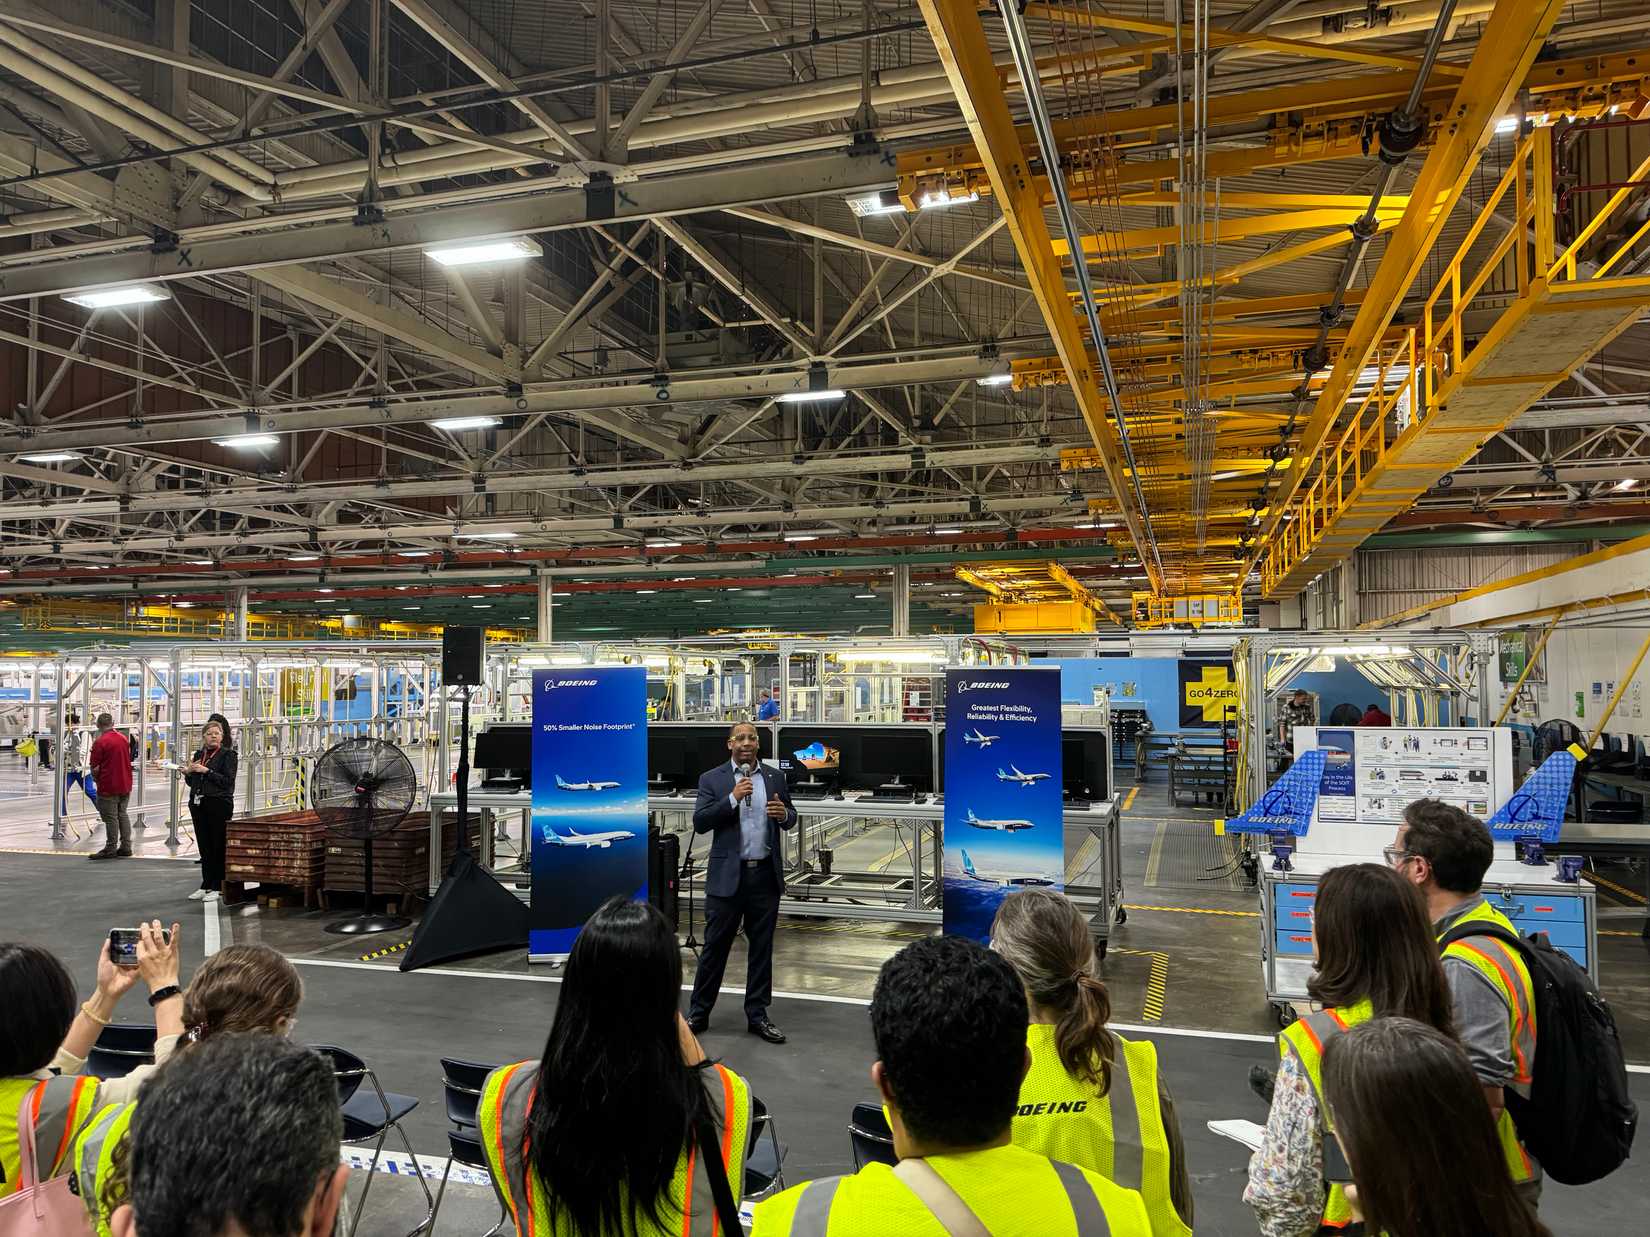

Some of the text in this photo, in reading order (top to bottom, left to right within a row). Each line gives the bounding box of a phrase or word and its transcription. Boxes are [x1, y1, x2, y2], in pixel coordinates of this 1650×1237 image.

[1000, 704, 1033, 713] Flexibility,
[967, 713, 998, 721] Reliability
[1005, 714, 1038, 723] Efficiency
[1016, 1101, 1088, 1116] OEING
